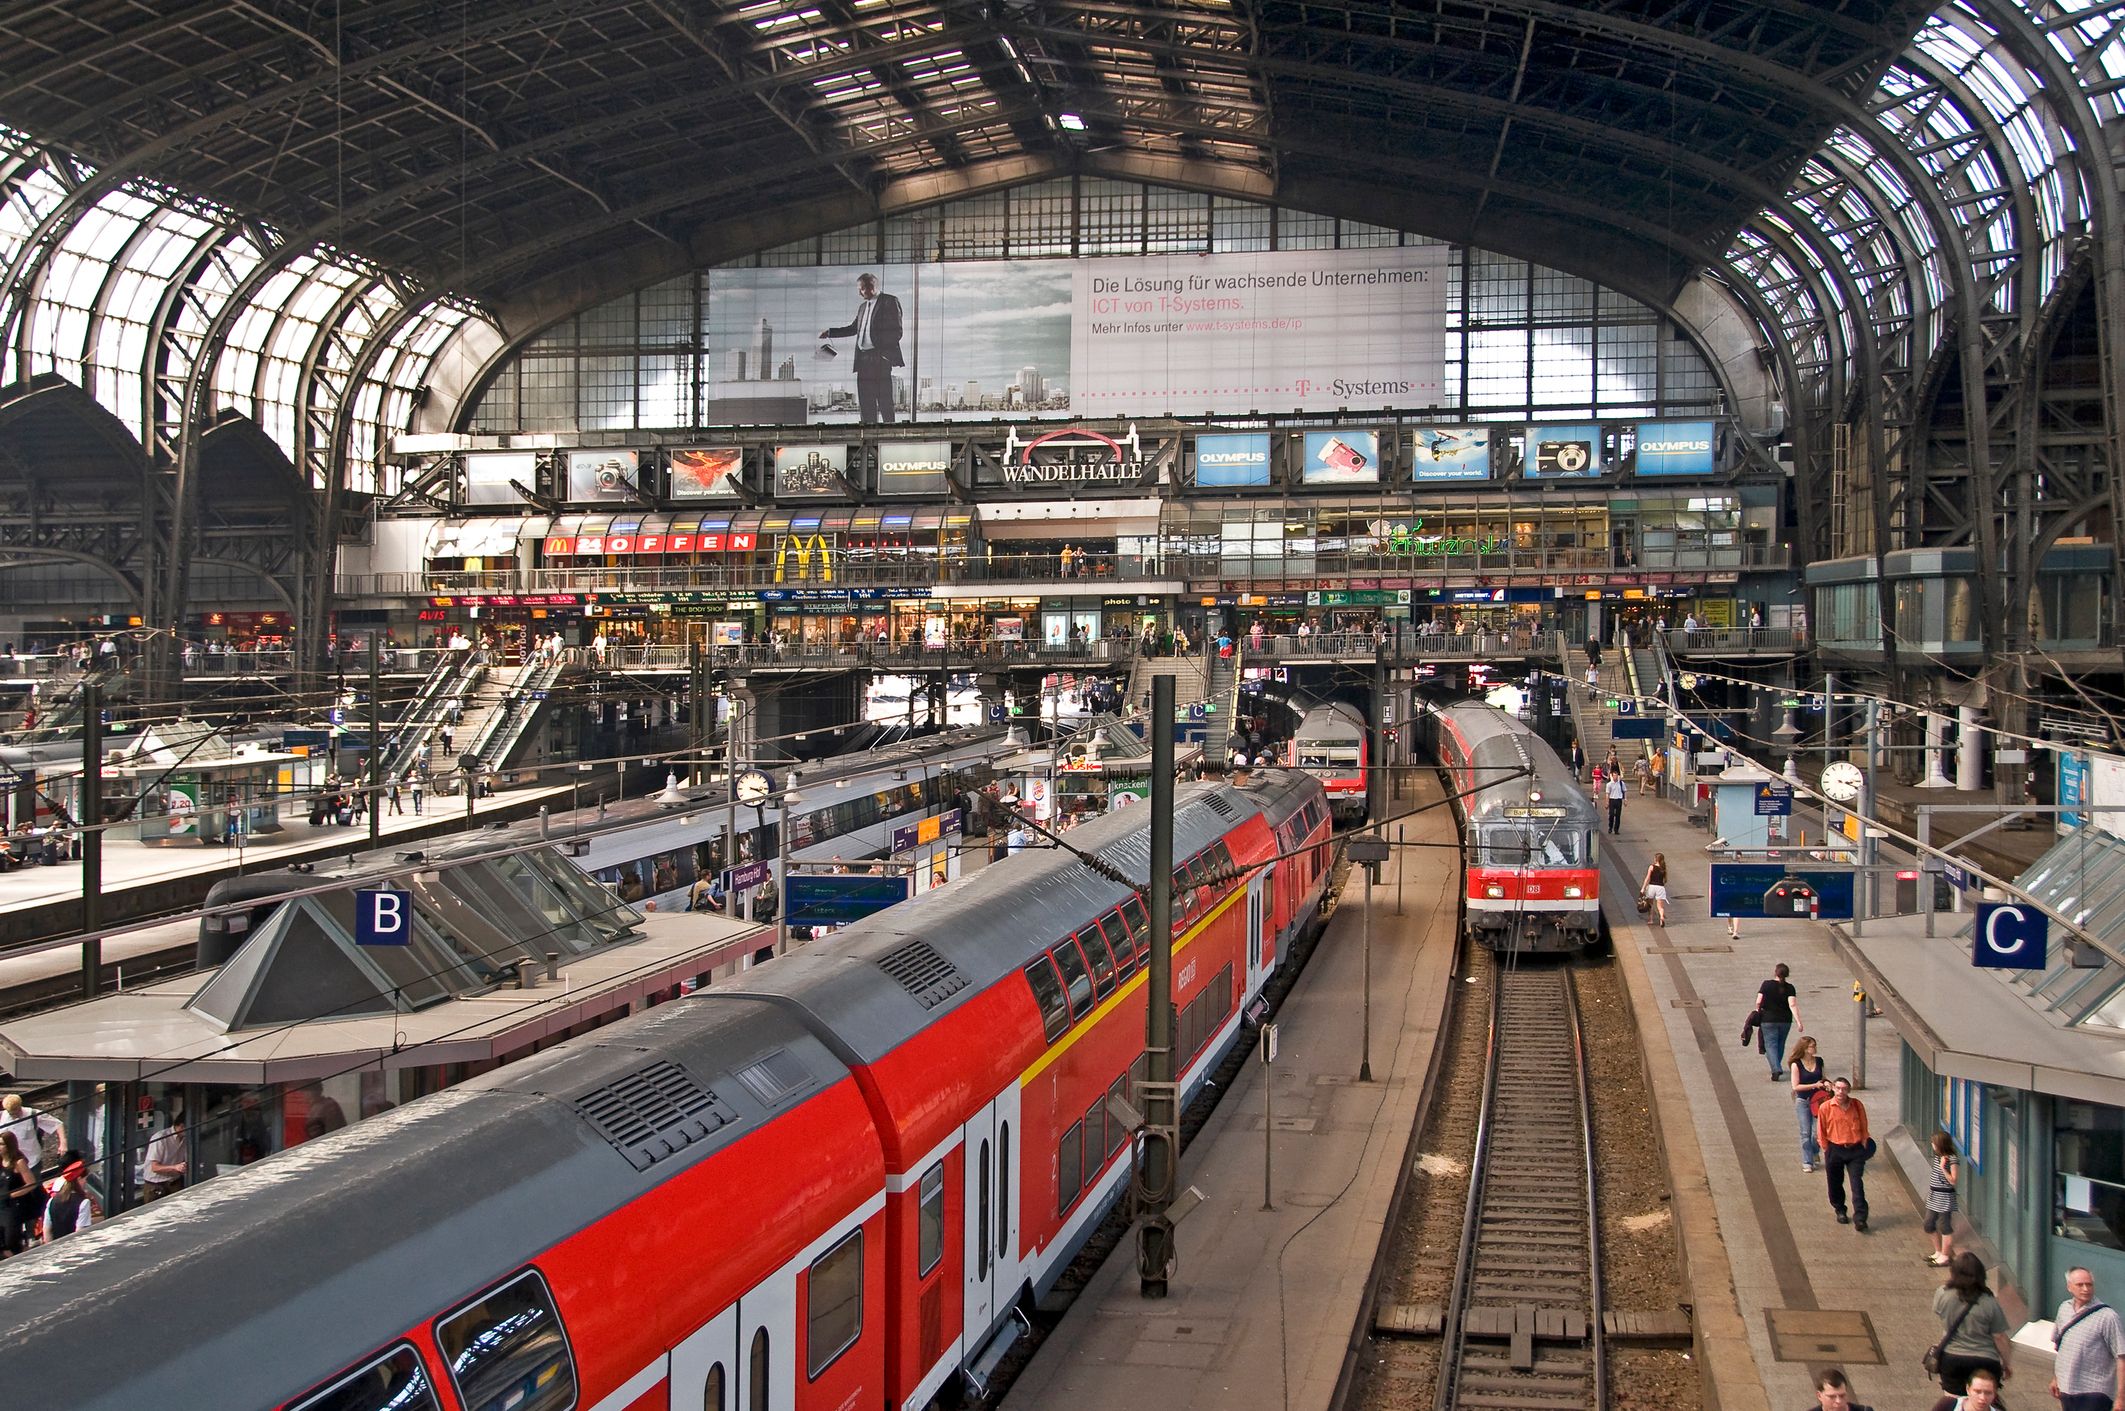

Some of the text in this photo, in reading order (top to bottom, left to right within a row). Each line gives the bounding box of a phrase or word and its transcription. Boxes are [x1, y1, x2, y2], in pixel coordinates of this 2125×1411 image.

[1094, 269, 1428, 294] Die Lösung für wachsende Unternehmen:
[1093, 296, 1244, 314] ICT von T-Systems.
[1092, 318, 1302, 334] Mehr Infos unter www.t-systems.de/ip
[1332, 378, 1408, 399] Systems
[1659, 440, 1710, 452] OLYMPUS
[1200, 452, 1265, 462] OLYMPUS
[882, 462, 946, 472] OLYMPUS
[1002, 464, 1142, 482] WANDELHALLE
[611, 536, 748, 551] OFFEN
[418, 611, 445, 620] AVIS
[1194, 704, 1204, 717] C
[1553, 699, 1560, 709] H
[1620, 701, 1630, 714] D
[334, 710, 342, 722] E
[990, 705, 1000, 718] C
[1384, 706, 1392, 718] H
[1114, 779, 1148, 790] knacken!
[375, 894, 402, 932] B
[1986, 906, 2025, 954] C
[1052, 1154, 1057, 1180] 2
